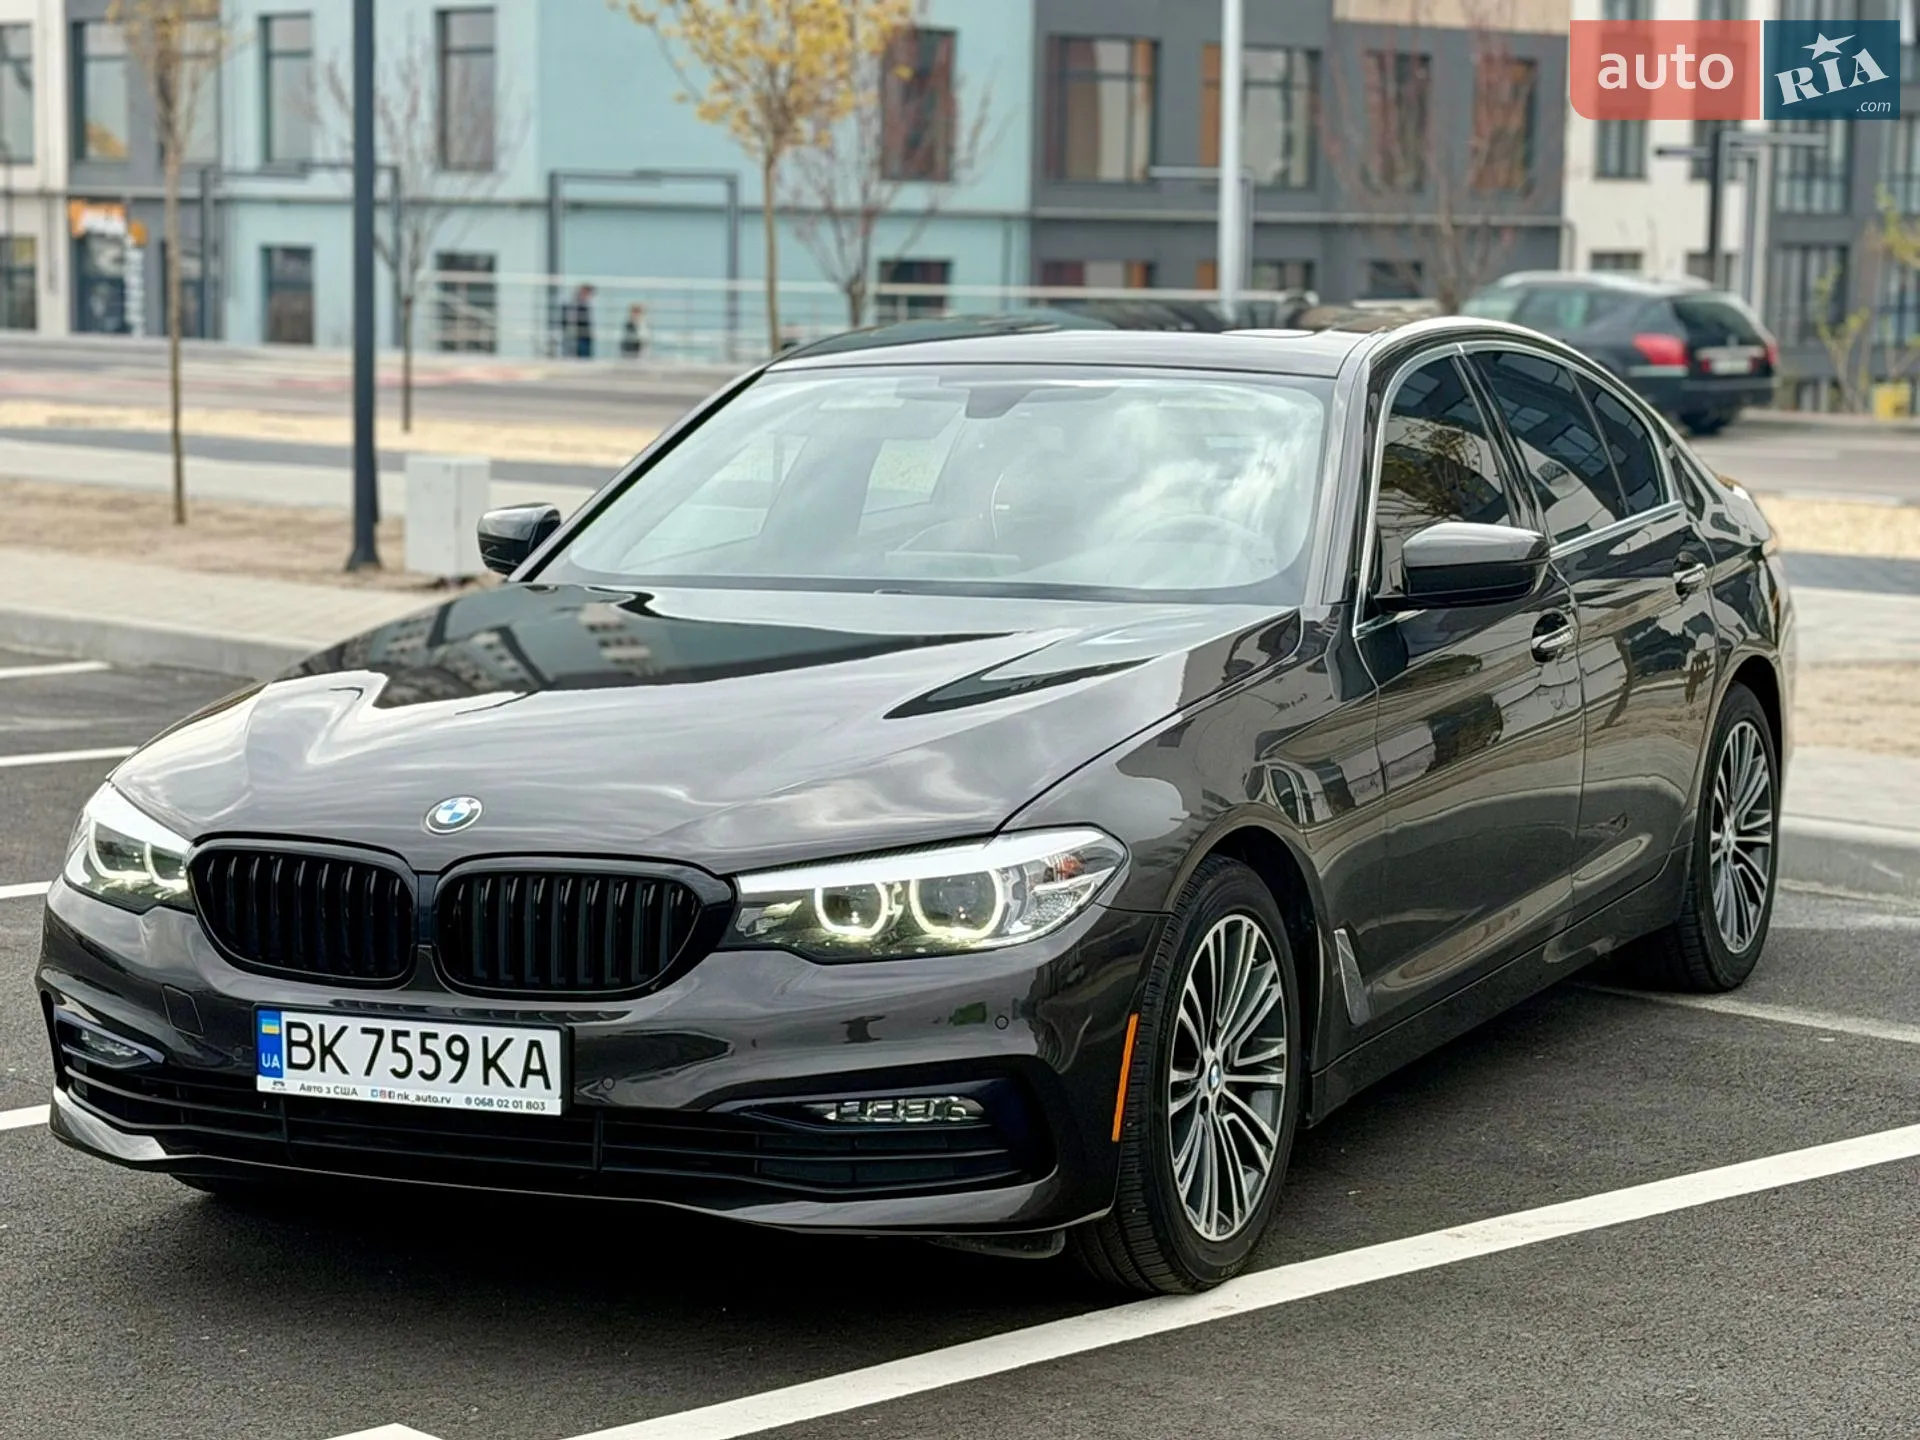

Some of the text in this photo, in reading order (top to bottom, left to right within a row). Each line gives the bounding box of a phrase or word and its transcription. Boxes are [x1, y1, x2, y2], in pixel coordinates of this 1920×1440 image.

[261, 1052, 281, 1069] UA
[286, 1021, 552, 1090] BK 7559 KA
[299, 1083, 323, 1094] Авто
[333, 1085, 358, 1097] США
[496, 1098, 510, 1109] 02
